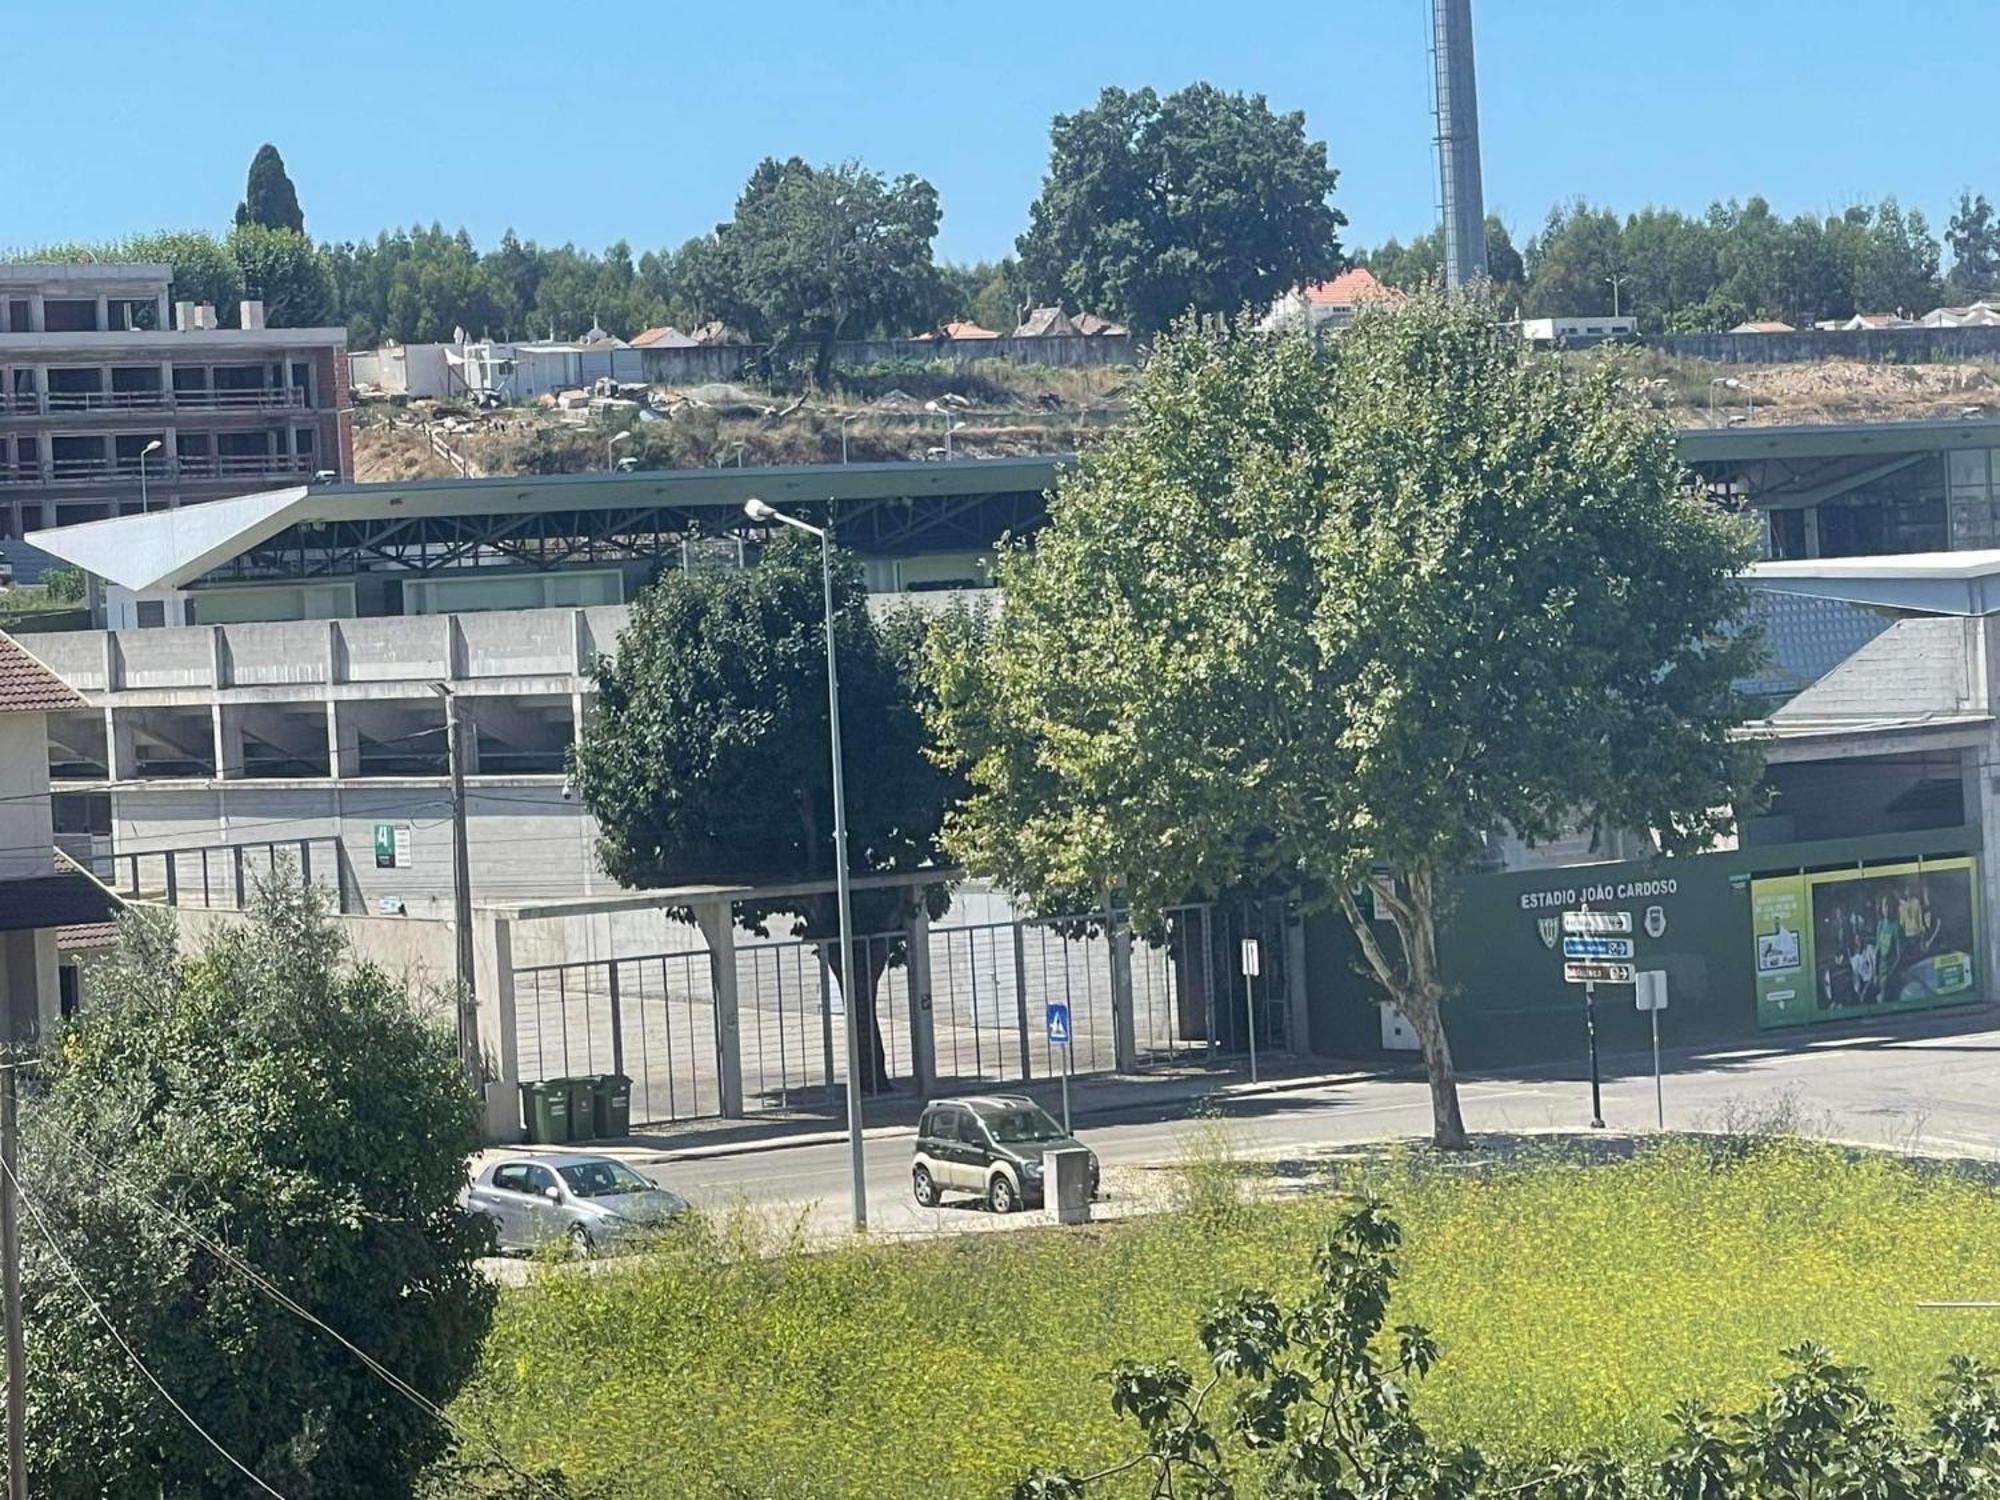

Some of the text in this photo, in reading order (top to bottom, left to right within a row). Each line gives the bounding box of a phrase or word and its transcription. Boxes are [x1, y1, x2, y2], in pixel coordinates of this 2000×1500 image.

[378, 826, 388, 848] 4
[1521, 879, 1678, 909] ESTADIO JOÃO CARDOSO
